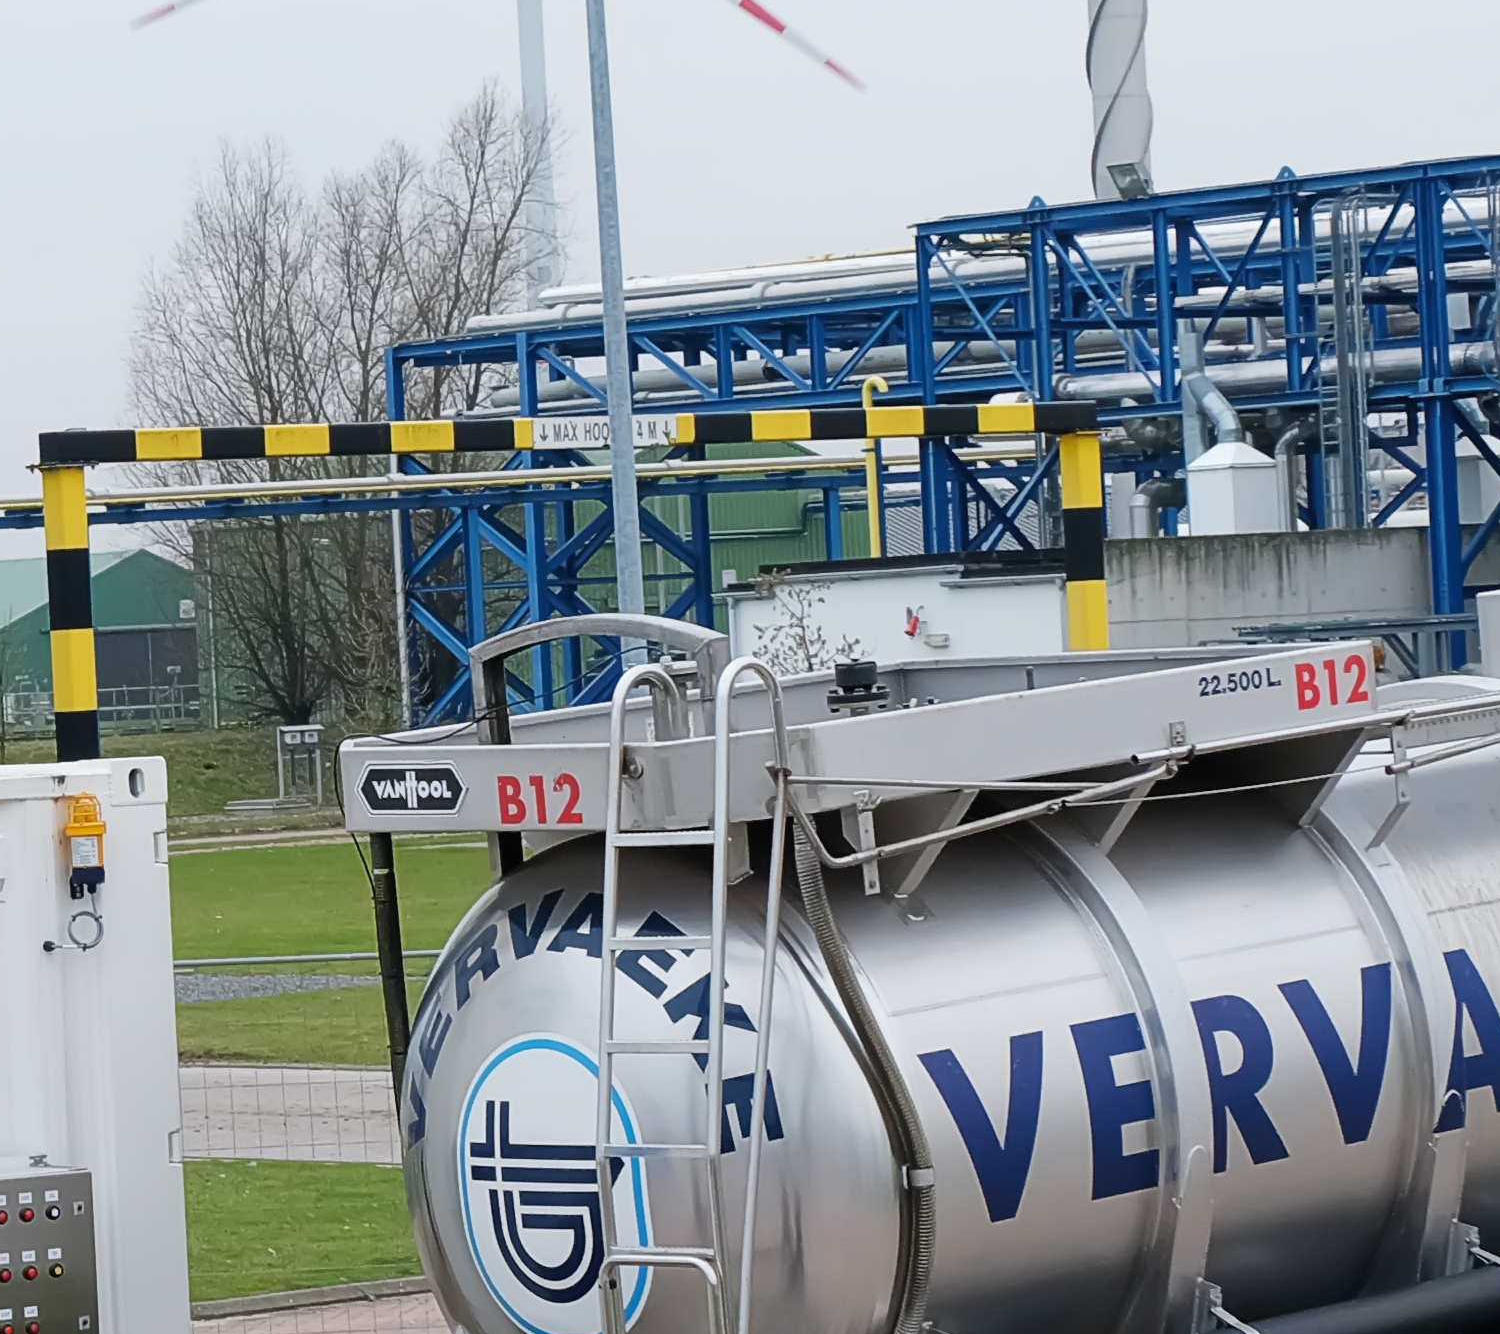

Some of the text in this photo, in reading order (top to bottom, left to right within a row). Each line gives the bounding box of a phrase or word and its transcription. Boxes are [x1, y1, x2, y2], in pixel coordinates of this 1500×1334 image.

[553, 421, 579, 442] MAX
[636, 420, 644, 440] 4
[648, 421, 657, 440] M
[1198, 670, 1263, 697] 22.500
[1295, 654, 1370, 711] B12
[496, 772, 584, 825] B12
